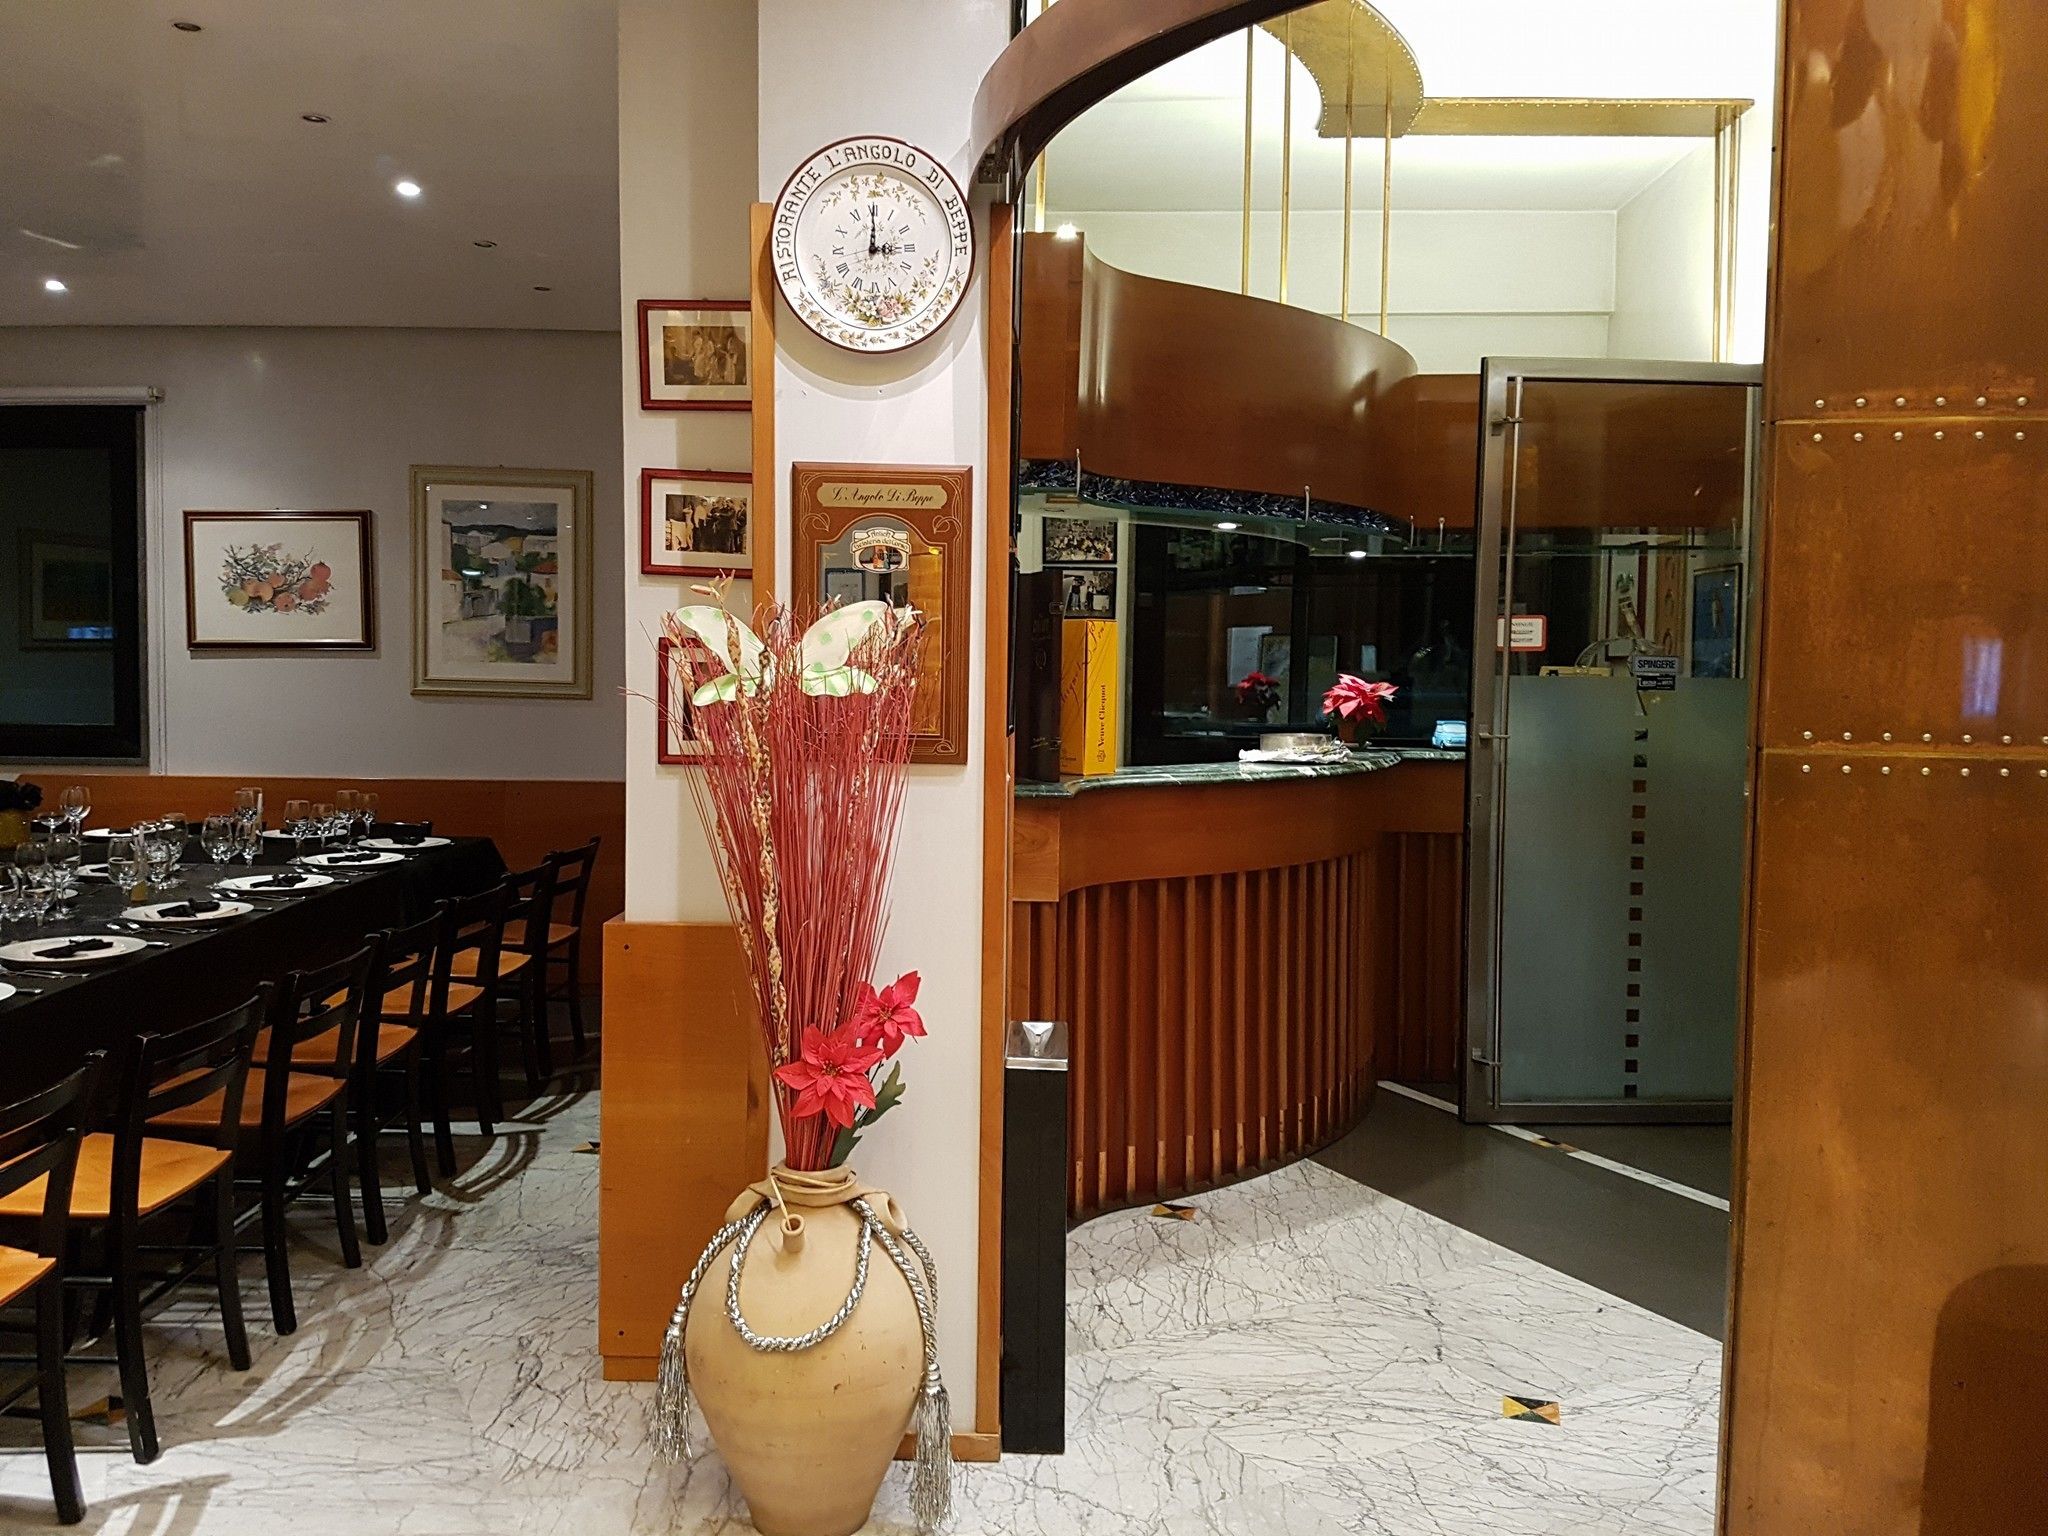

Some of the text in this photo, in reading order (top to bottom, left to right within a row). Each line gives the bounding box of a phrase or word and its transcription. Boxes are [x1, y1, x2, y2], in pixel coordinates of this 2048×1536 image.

[775, 144, 968, 284] RISTORANTE L'ANGOLO DI BEPPE
[835, 225, 848, 238] X
[898, 225, 910, 235] II
[903, 243, 916, 253] III
[886, 488, 902, 502] Di
[902, 488, 934, 506] Beppe
[1637, 659, 1676, 669] SPINGERE
